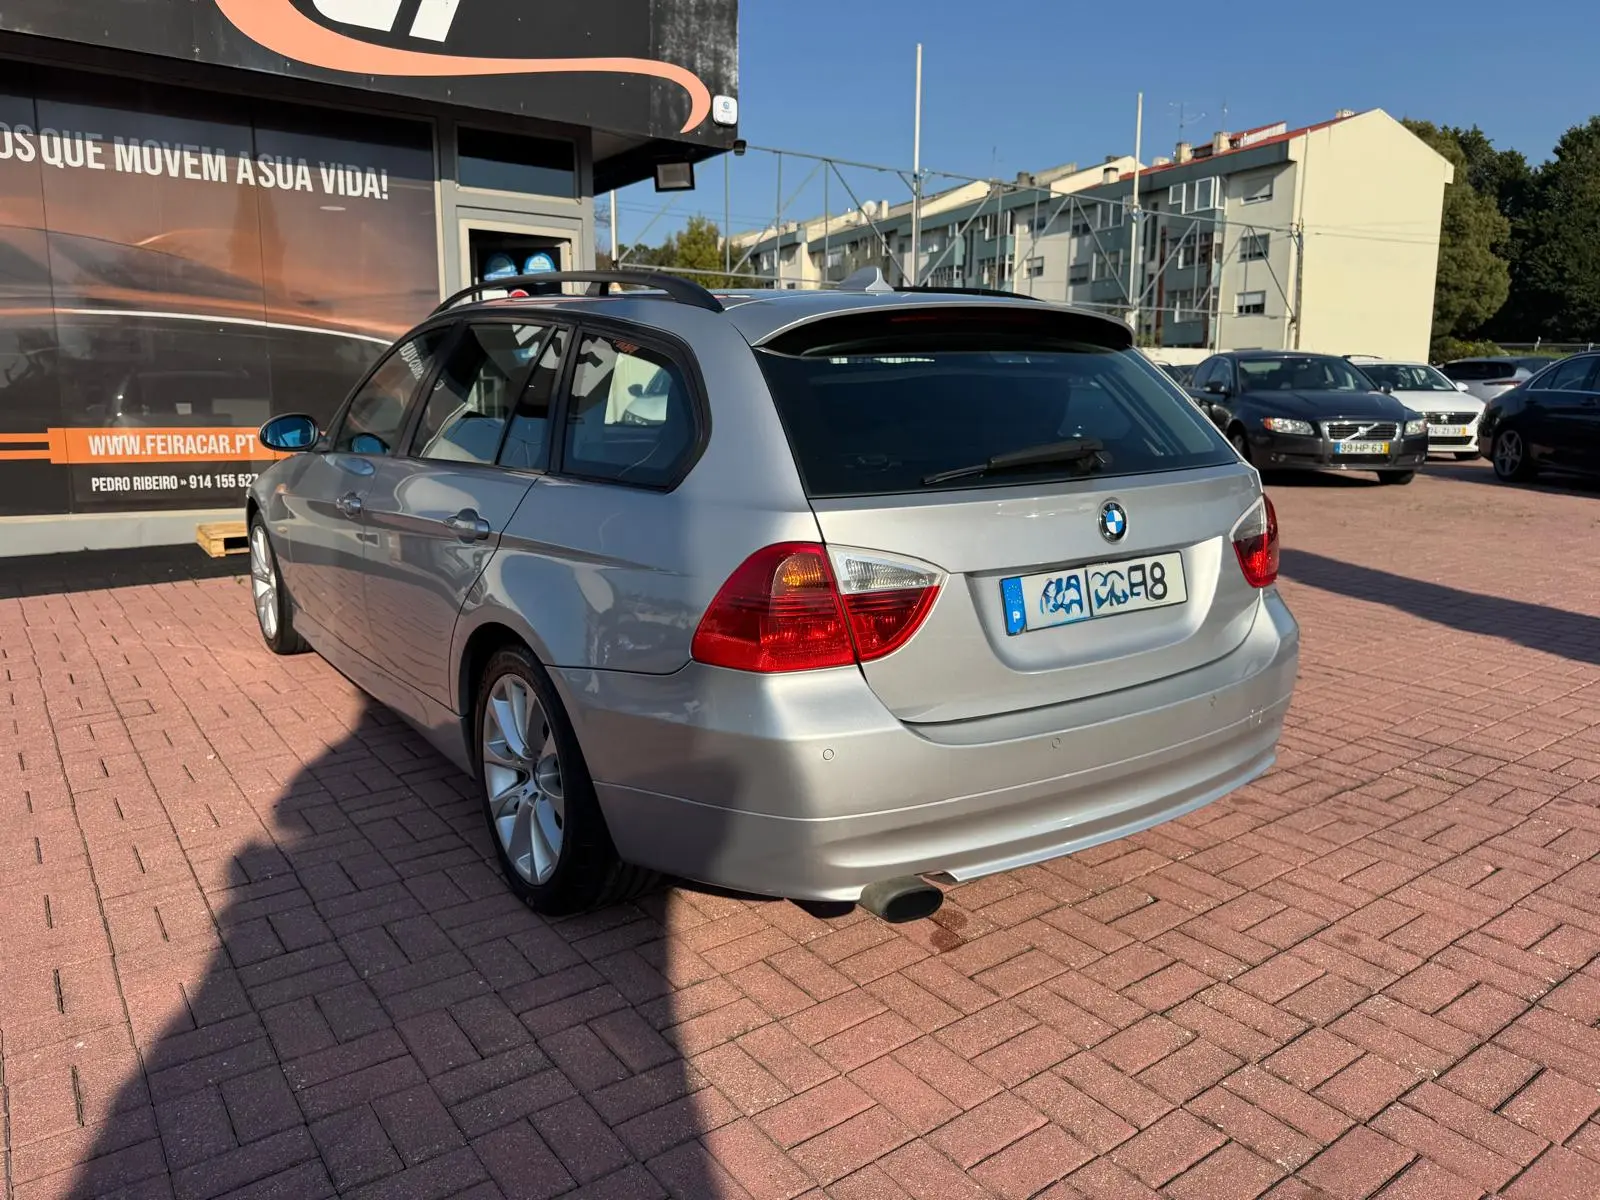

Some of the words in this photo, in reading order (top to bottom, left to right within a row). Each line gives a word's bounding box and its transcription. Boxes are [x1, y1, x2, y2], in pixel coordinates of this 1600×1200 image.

[40, 127, 106, 169] QUE
[113, 135, 228, 183] MOVEM
[236, 150, 256, 186] A
[257, 153, 314, 192] SUA
[319, 161, 389, 200] VIDA!
[88, 434, 257, 456] WWW.FEIRACAR.PT
[91, 476, 131, 492] PEDRO
[133, 475, 178, 491] RIBEIRO
[189, 474, 212, 489] 914
[214, 474, 235, 488] 155
